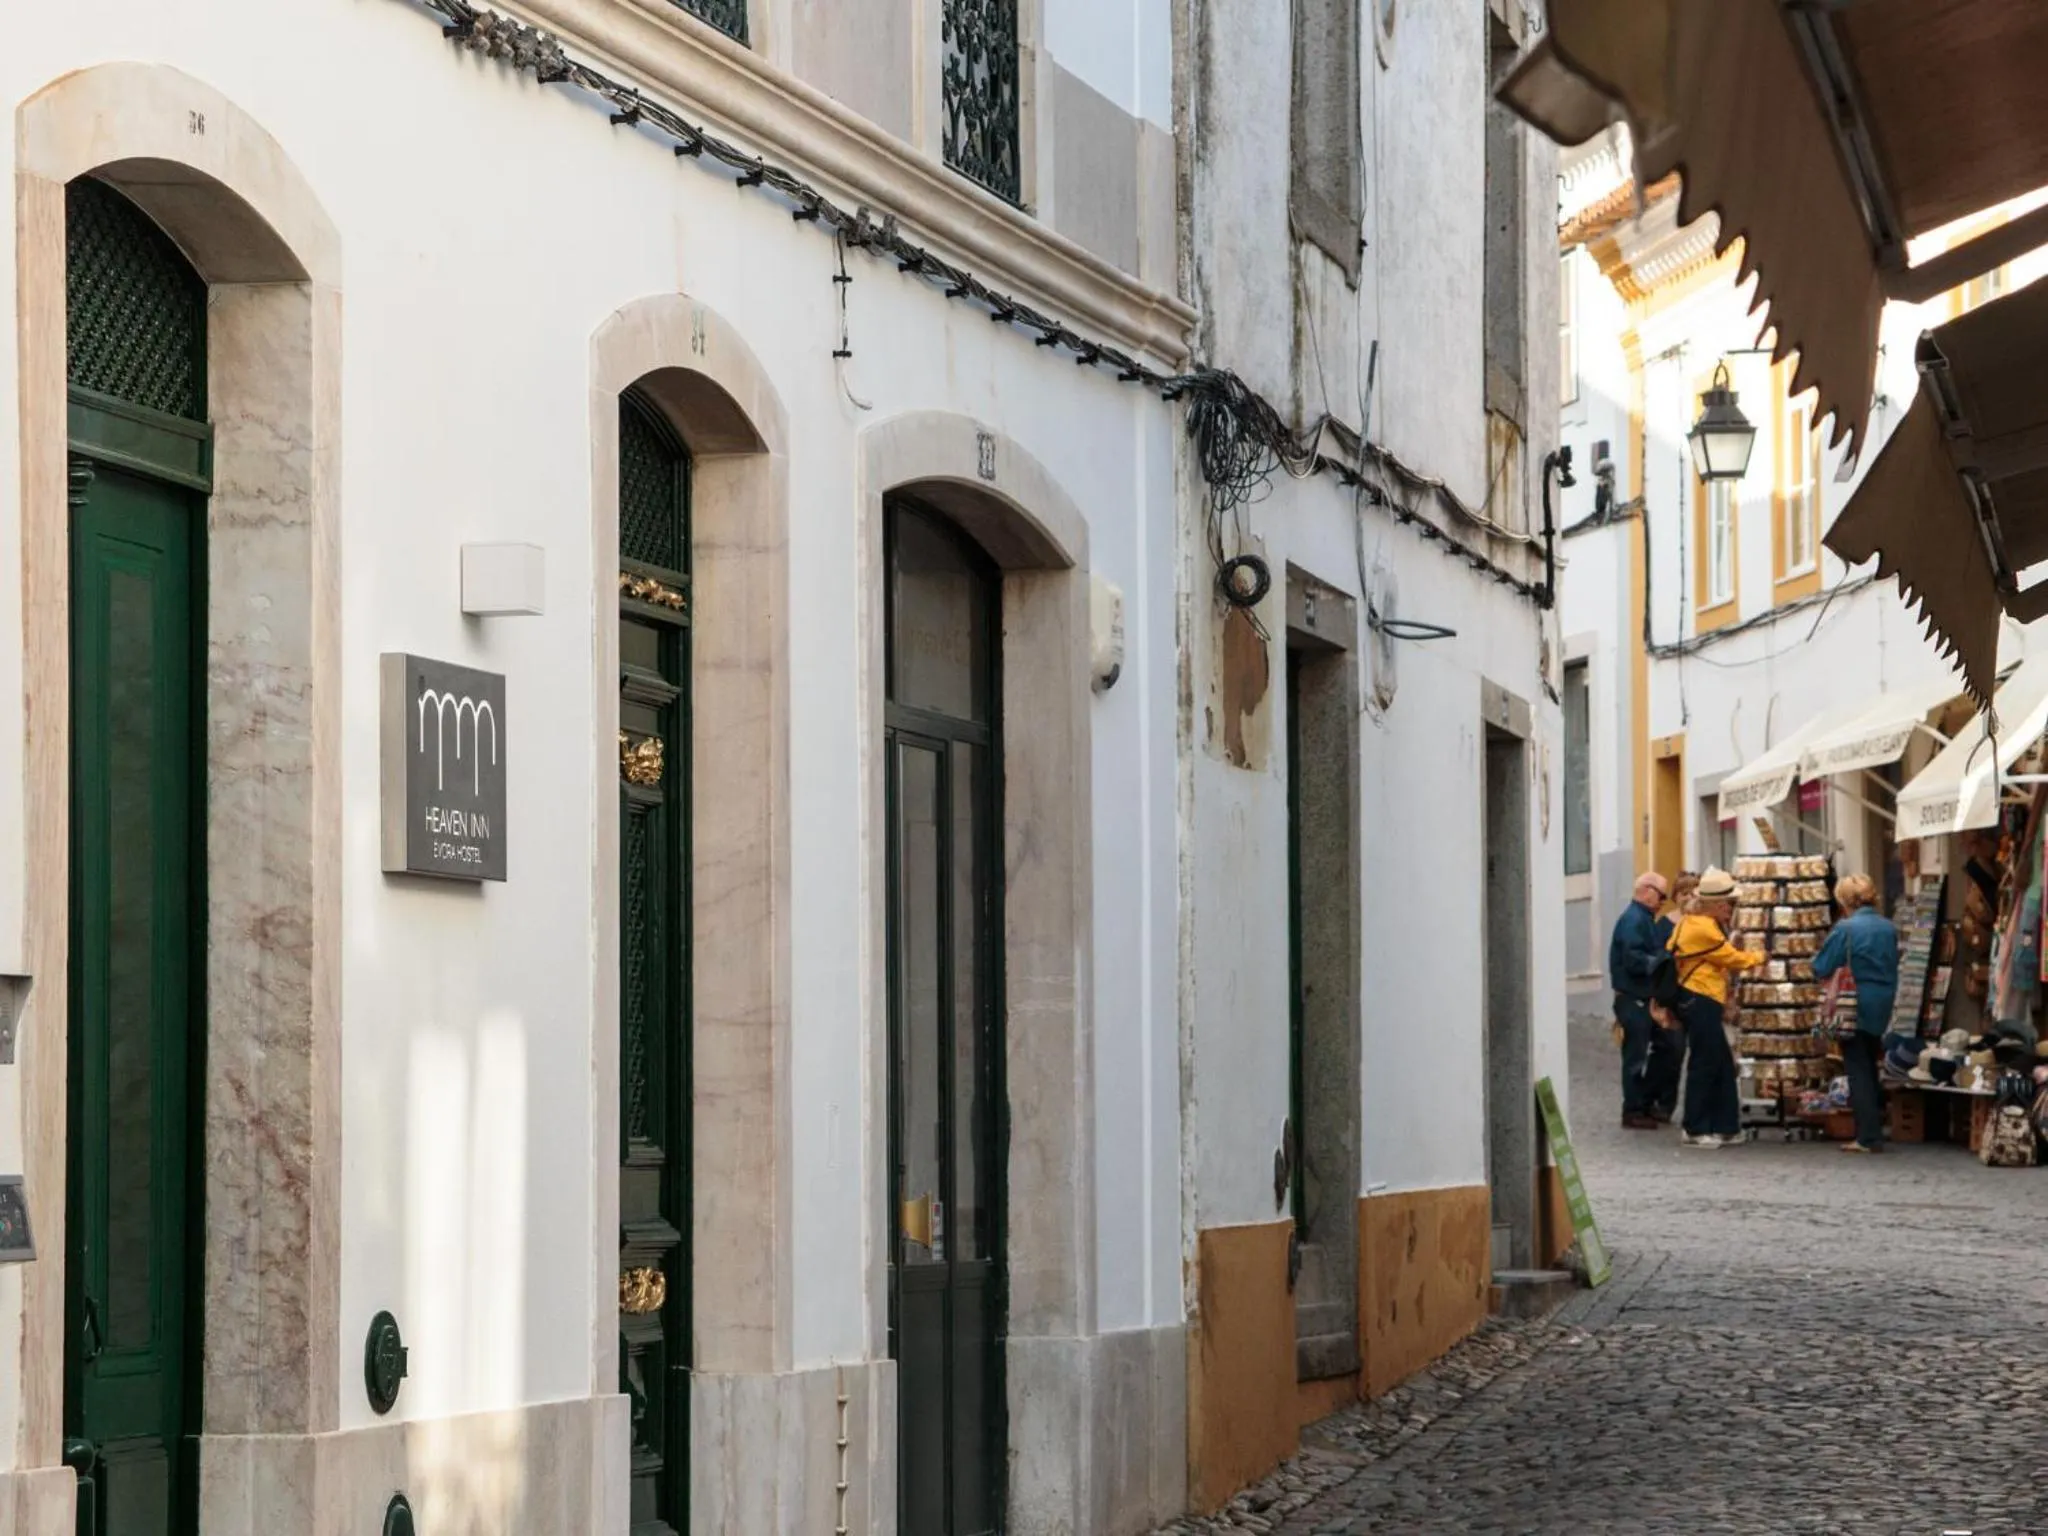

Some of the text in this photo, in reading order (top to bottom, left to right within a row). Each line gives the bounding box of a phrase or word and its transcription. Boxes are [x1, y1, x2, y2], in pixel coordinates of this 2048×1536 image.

[425, 806, 491, 841] HEAVEN INN
[456, 844, 483, 864] HOSTEL
